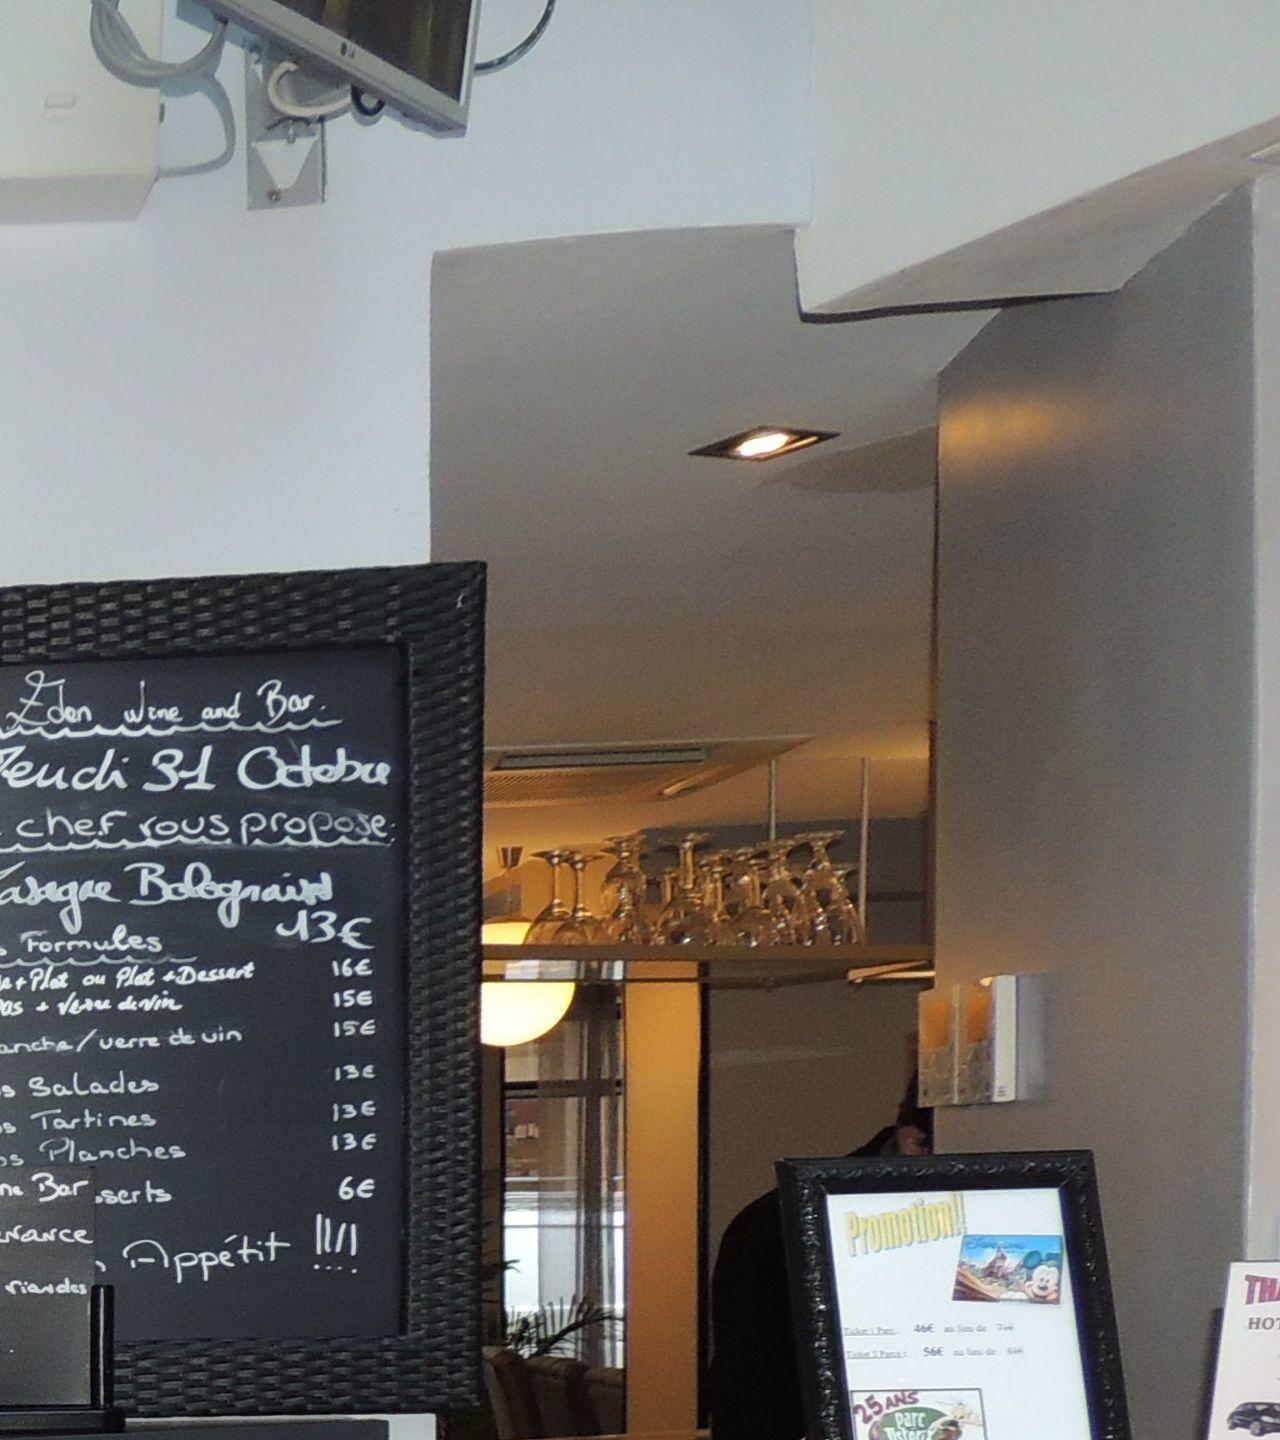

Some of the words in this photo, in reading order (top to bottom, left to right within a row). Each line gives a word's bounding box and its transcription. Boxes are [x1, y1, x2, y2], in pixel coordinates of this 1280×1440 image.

[124, 680, 182, 722] Wine
[201, 692, 241, 721] and
[142, 745, 216, 792] 31
[237, 745, 391, 790] Octobre
[16, 808, 127, 838] chef
[21, 924, 162, 954] Formules
[275, 910, 375, 949] 13€
[82, 974, 106, 986] ou
[332, 959, 373, 977] 16€
[333, 991, 372, 1008] 15€
[169, 1027, 195, 1045] de
[201, 1026, 242, 1043] vin
[333, 1020, 375, 1037] 15€
[29, 1071, 160, 1095] Salades
[335, 1064, 378, 1081] 13€
[31, 1108, 157, 1132] Tartines
[332, 1100, 377, 1121] 13€
[40, 1137, 186, 1161] Planches
[331, 1133, 377, 1151] 13€
[32, 1172, 89, 1202] Bar
[339, 1177, 375, 1199] 6€
[123, 1231, 290, 1283] Appétit
[852, 1394, 883, 1424] 25
[886, 1391, 920, 1410] ANS
